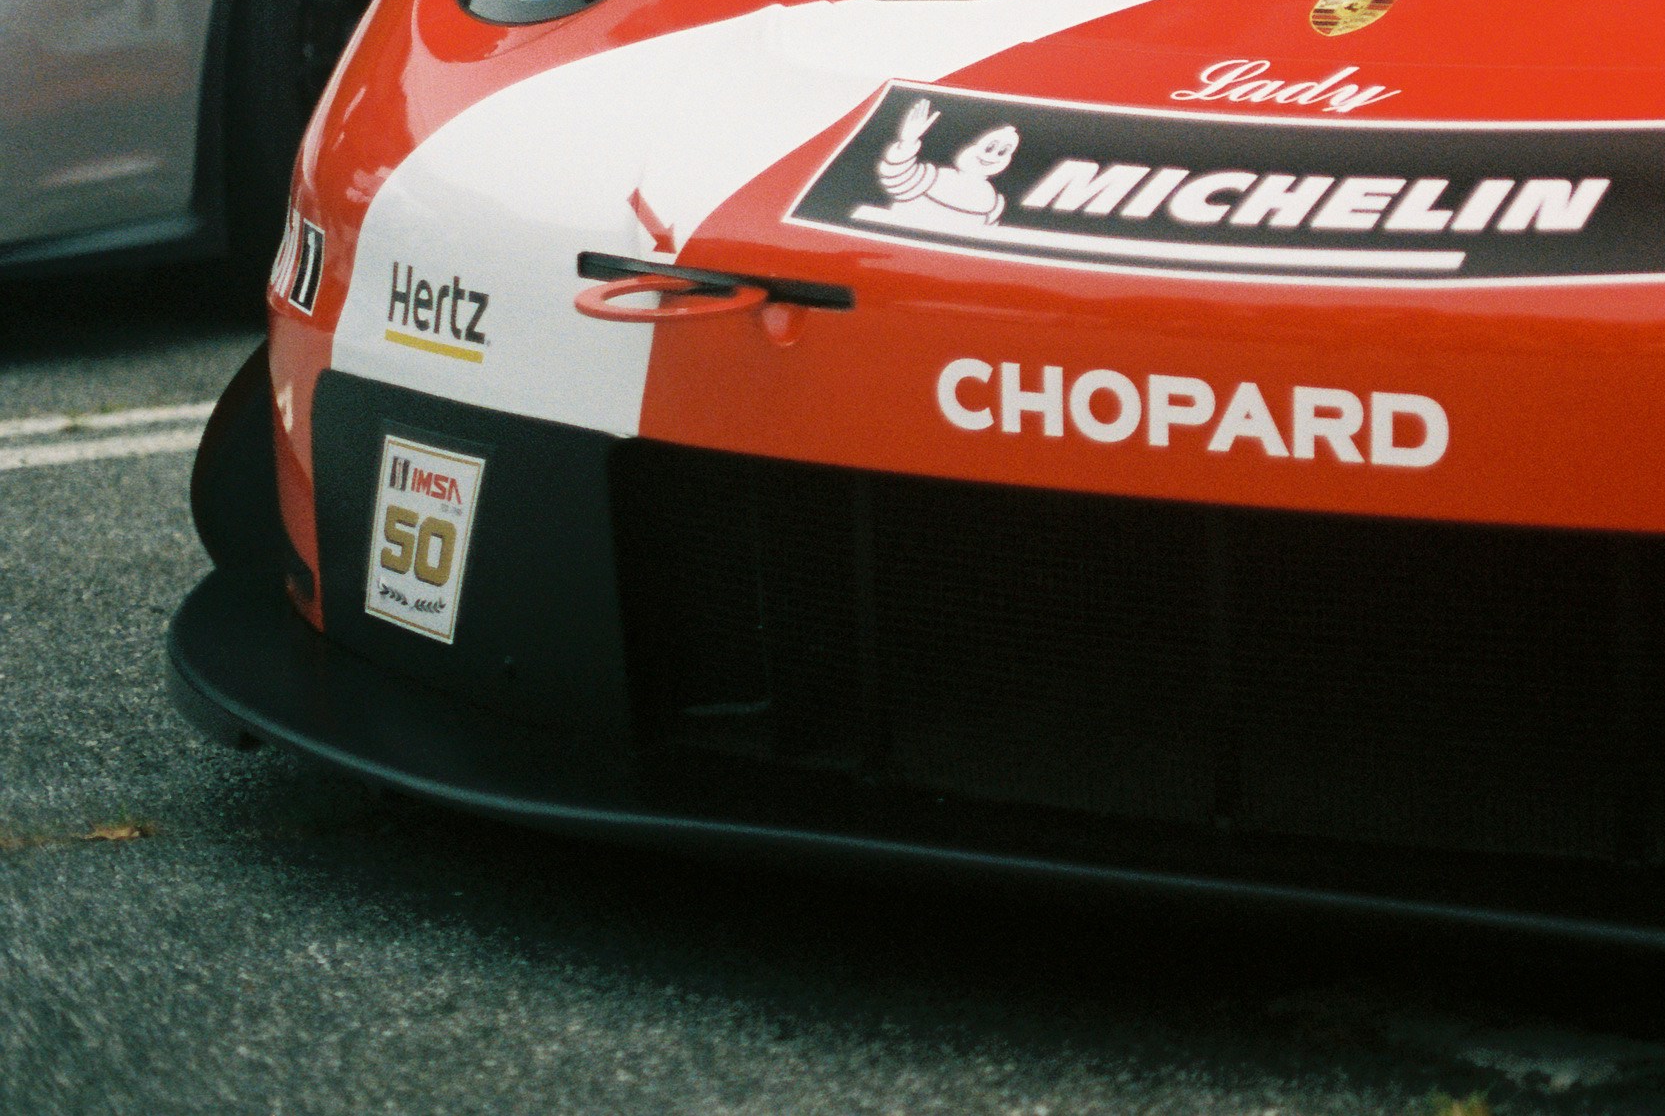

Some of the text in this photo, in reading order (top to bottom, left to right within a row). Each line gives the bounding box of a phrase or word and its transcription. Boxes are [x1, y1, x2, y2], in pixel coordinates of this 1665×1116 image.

[1171, 58, 1401, 113] Lady
[1023, 158, 1611, 234] MICHELIN
[387, 261, 490, 345] Hertz
[936, 357, 1450, 469] CHOPARD
[410, 466, 463, 505] IMSA
[380, 504, 458, 587] 50
